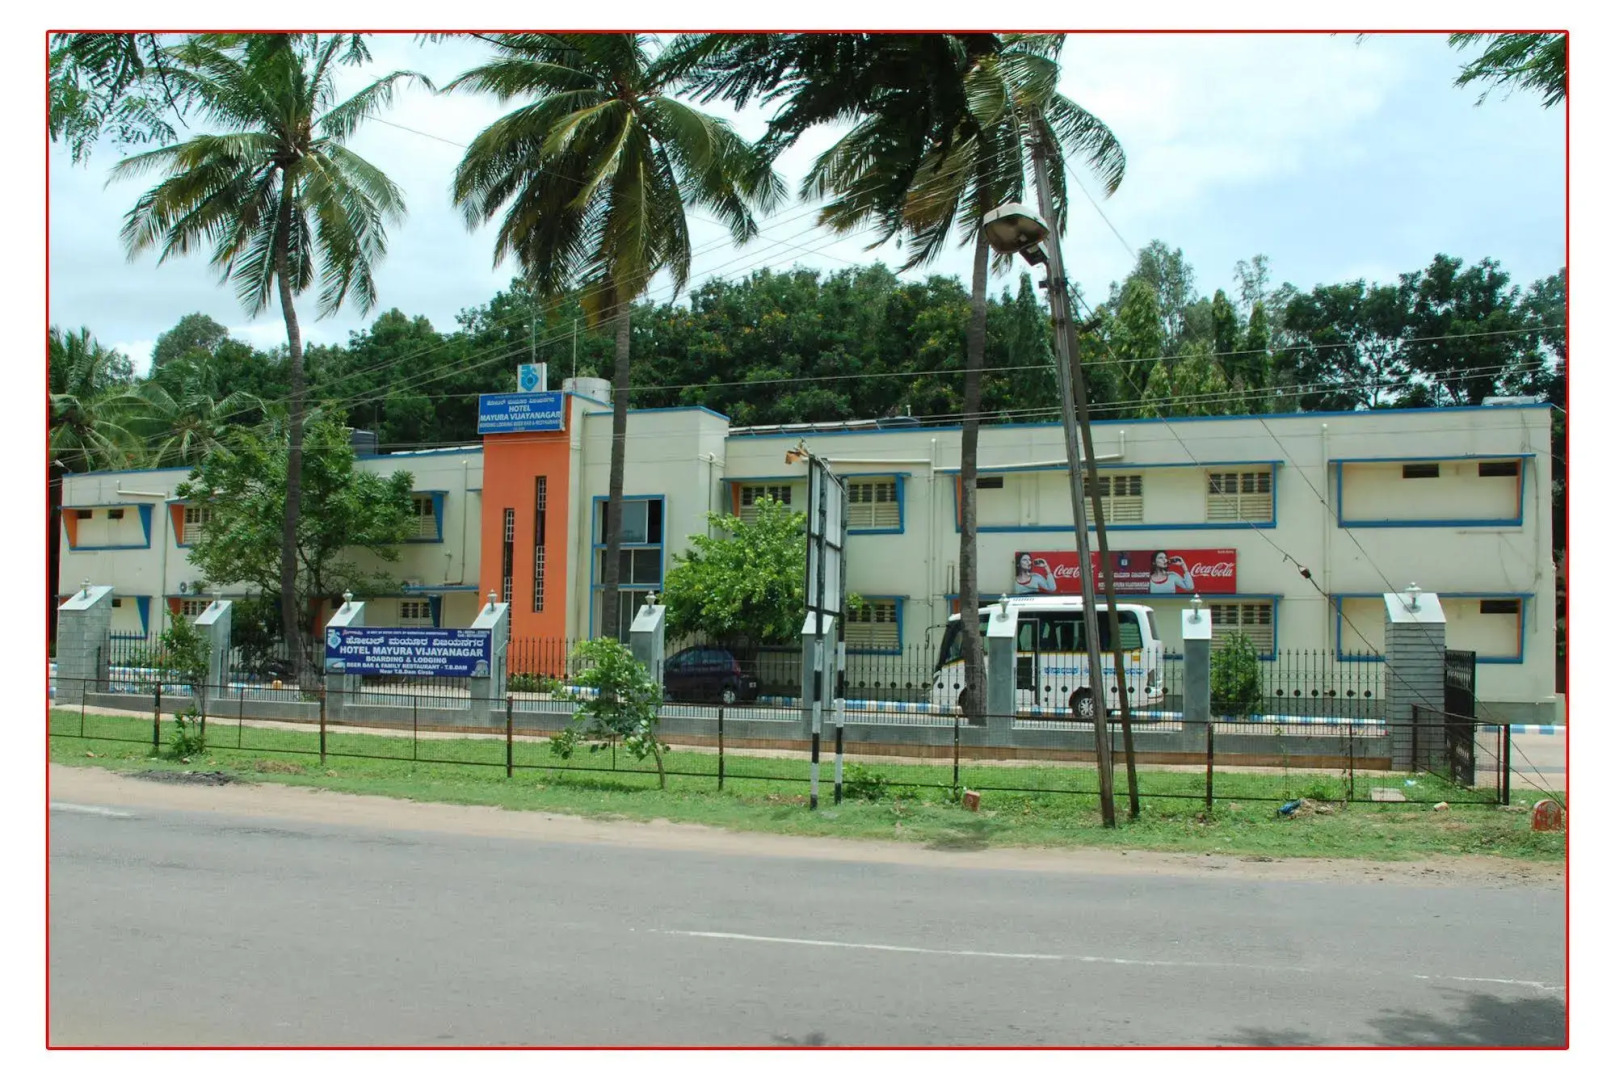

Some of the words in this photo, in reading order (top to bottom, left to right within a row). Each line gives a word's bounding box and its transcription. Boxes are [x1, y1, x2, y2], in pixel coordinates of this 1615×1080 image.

[480, 413, 509, 421] MAYURA
[510, 411, 561, 420] VIJAYANAGAR
[1191, 562, 1235, 577] Coca-Cola
[340, 645, 370, 654] HOTEL
[373, 646, 413, 655] MAYURA
[415, 646, 483, 657] VIJAYANAGAR
